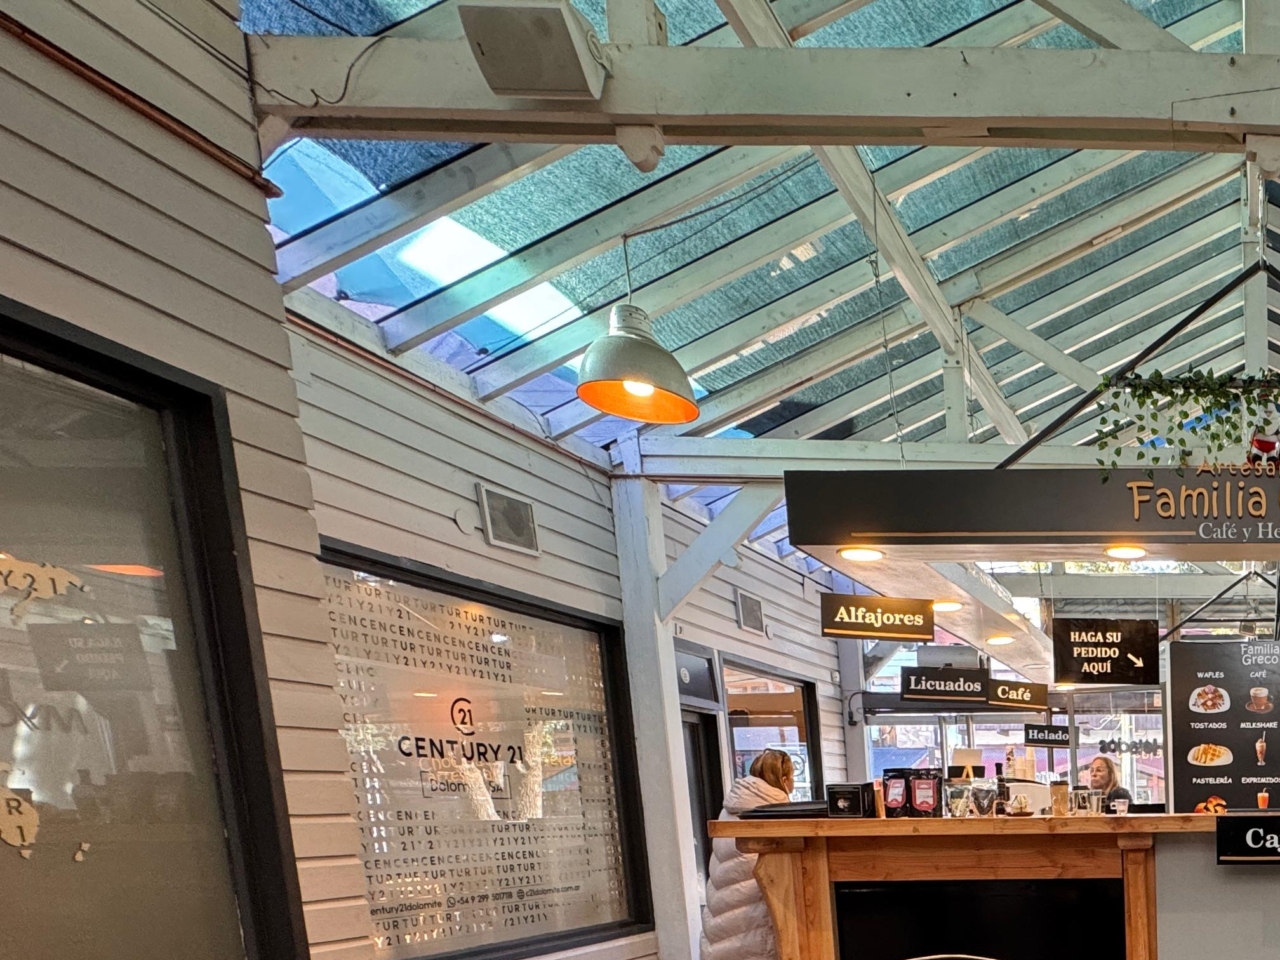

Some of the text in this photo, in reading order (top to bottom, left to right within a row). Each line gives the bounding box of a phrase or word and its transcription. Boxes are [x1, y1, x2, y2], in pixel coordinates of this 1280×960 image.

[1126, 480, 1267, 520] Familia
[1199, 522, 1237, 540] Café
[1242, 527, 1252, 543] y
[834, 605, 924, 628] Alfajores
[1070, 631, 1122, 644] HAGA SU
[1073, 647, 1120, 658] PEDIDO
[1240, 643, 1280, 655] Familia
[1242, 654, 1279, 666] Greco
[1081, 660, 1112, 674] AQUÍ
[1250, 670, 1267, 678] CAFÉ
[909, 676, 982, 693] Licuados
[997, 685, 1032, 701] Café
[1240, 721, 1278, 729] MILKSHAKE
[1028, 729, 1070, 740] Helado
[398, 735, 501, 763] CENTURY
[507, 745, 524, 764] 21
[1192, 776, 1232, 784] PASTELERÍA
[370, 900, 442, 916] entury21dolomite
